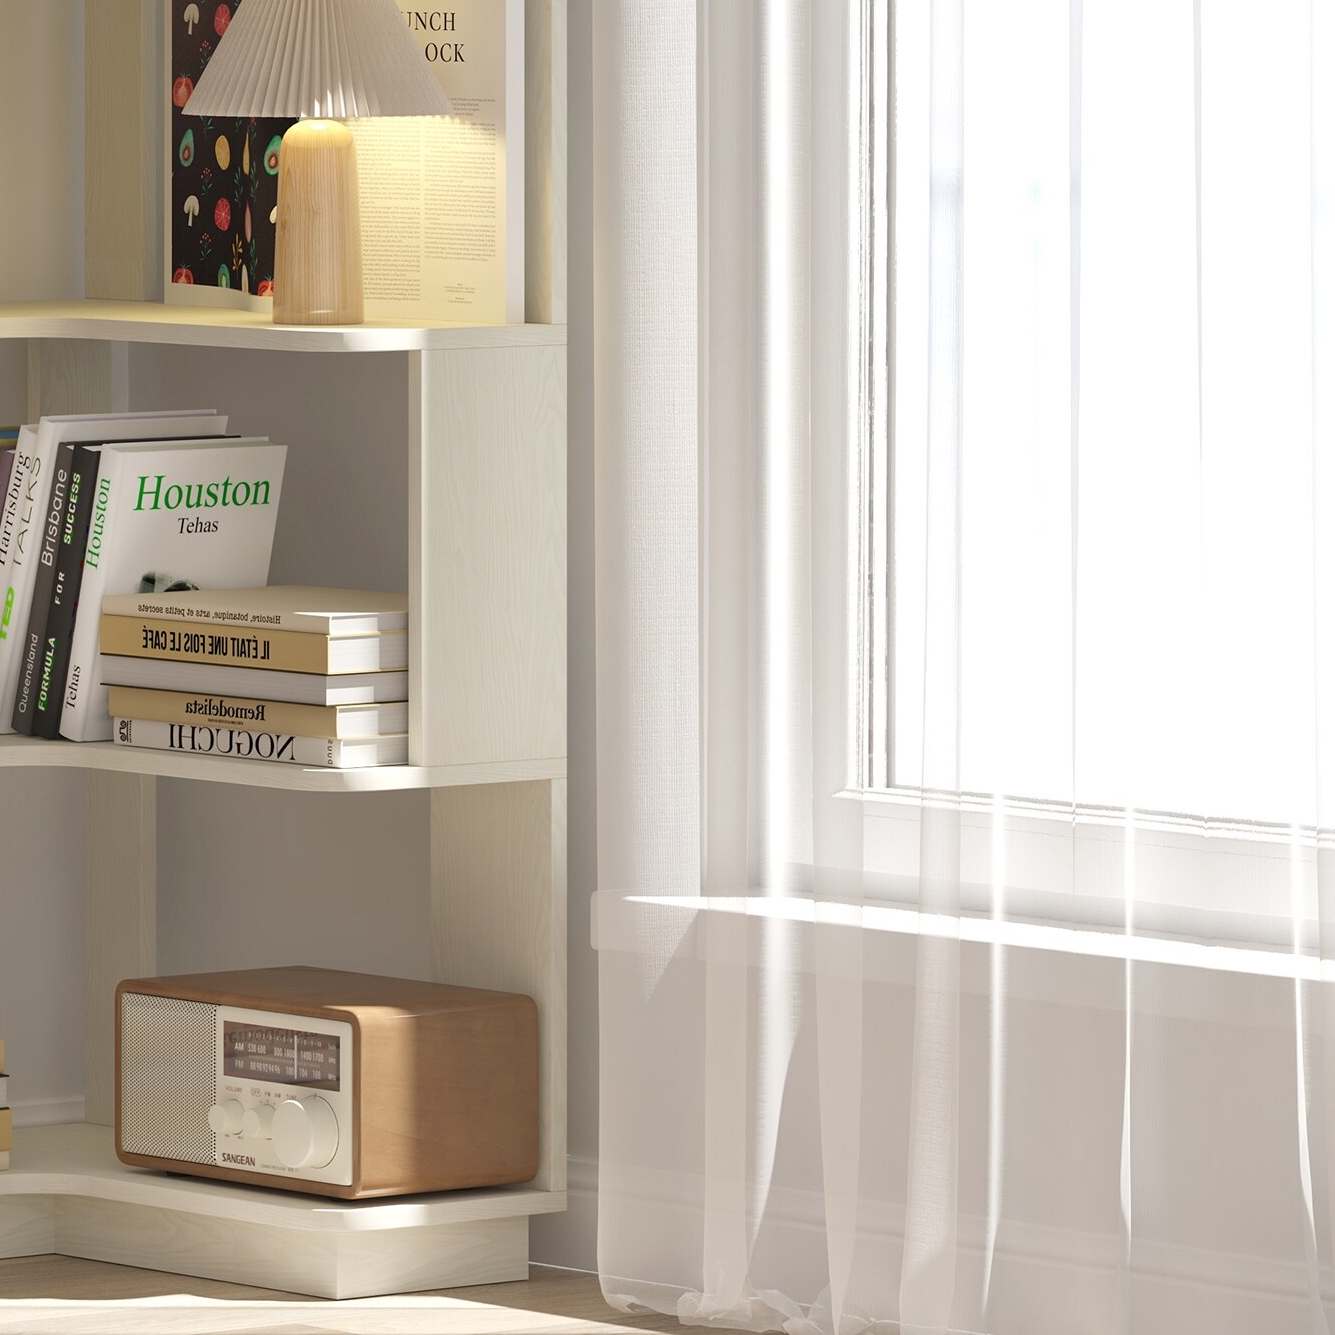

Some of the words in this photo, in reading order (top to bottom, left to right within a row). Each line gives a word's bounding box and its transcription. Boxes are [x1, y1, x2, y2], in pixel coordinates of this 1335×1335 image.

[132, 473, 270, 513] Houston
[41, 469, 67, 567] Brisbane
[177, 517, 218, 535] Tehas
[37, 637, 56, 711] FORMULA
[54, 571, 65, 605] FOR
[64, 473, 81, 545] SUCCESS
[65, 665, 81, 709] Tehas
[86, 478, 111, 570] Houston
[18, 633, 39, 713] Queensland
[234, 1043, 245, 1051] AM
[235, 1060, 244, 1068] FM
[222, 1153, 256, 1167] SANGEAN
